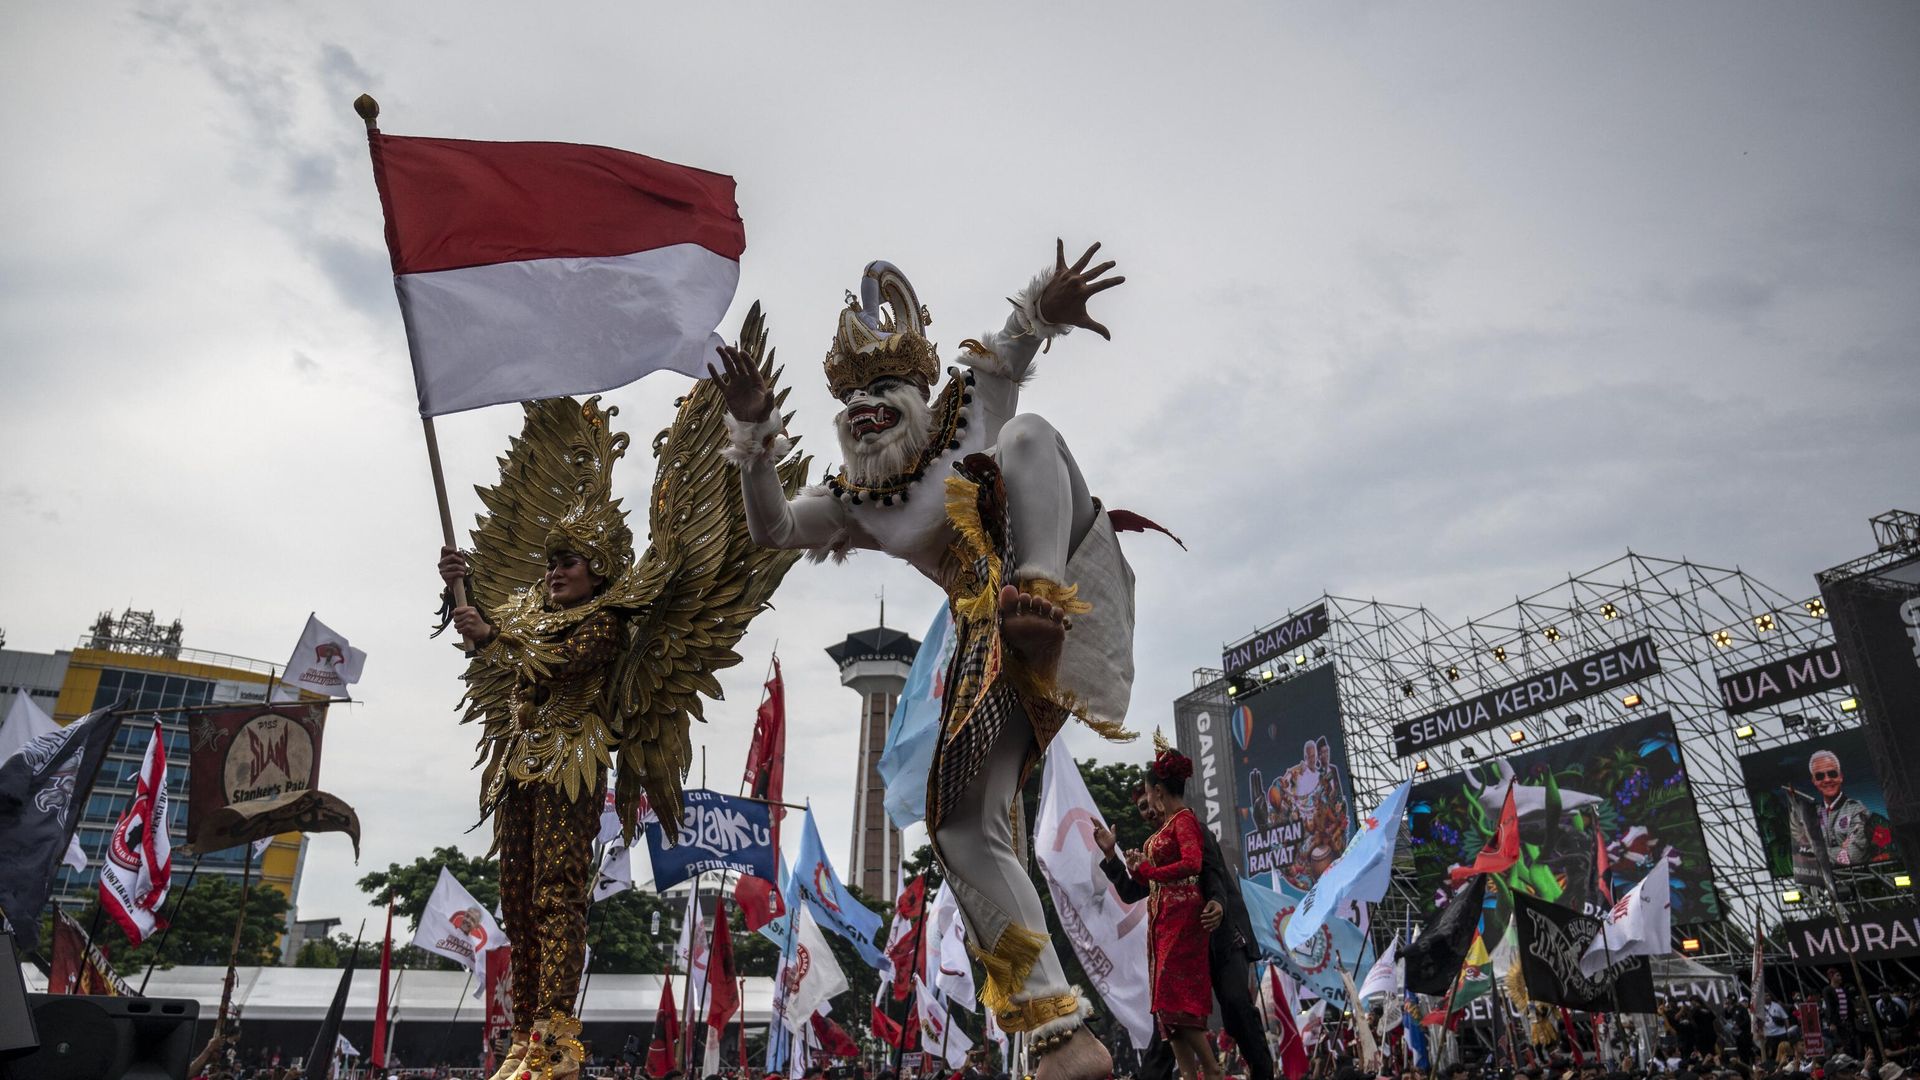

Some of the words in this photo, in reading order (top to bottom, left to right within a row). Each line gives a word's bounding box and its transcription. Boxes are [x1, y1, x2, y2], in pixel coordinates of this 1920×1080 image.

[1255, 612, 1315, 660] RAKYAT
[1785, 650, 1842, 690] MU
[1410, 702, 1490, 745] SEMUA
[1495, 671, 1579, 717] KERJA
[1196, 711, 1223, 843] GANJAR
[1247, 820, 1303, 852] HAJATAN
[1249, 848, 1296, 874] RAKYAT
